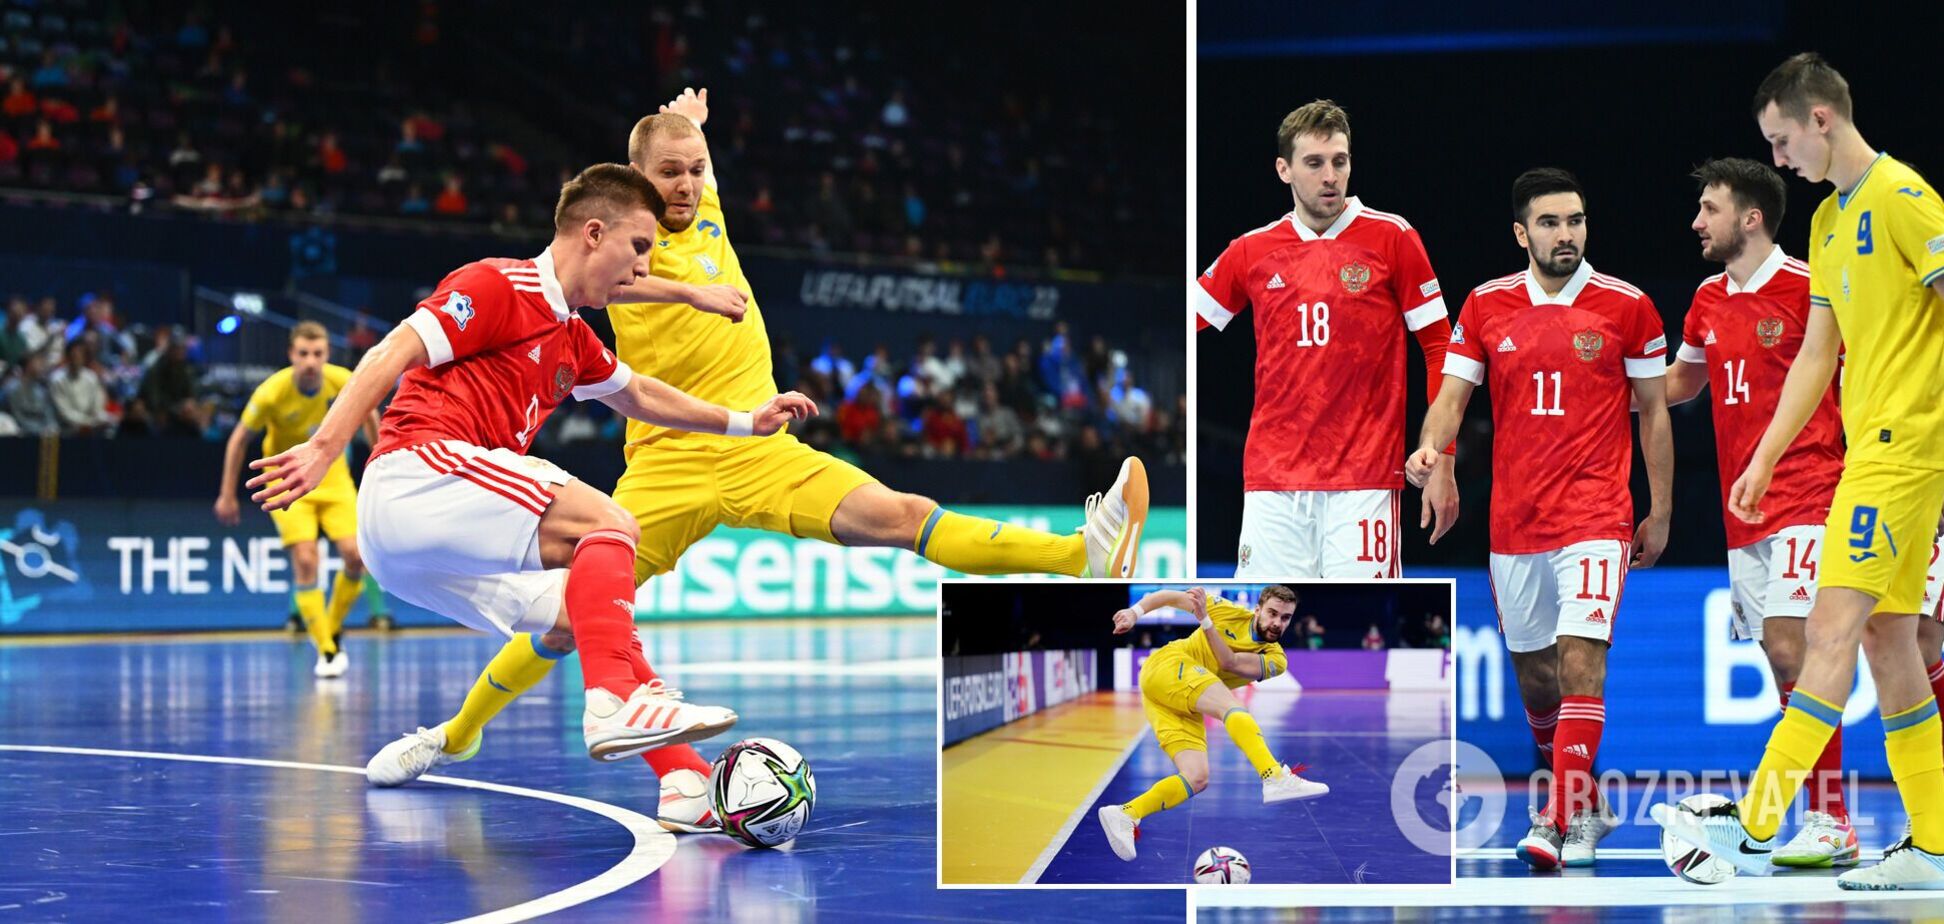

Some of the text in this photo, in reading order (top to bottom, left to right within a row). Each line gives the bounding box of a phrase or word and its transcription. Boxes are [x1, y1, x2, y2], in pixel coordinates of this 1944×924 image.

[1857, 210, 1874, 256] 9
[1296, 301, 1330, 347] 18
[1530, 370, 1566, 416] 11
[1723, 358, 1751, 406] 14
[1357, 518, 1387, 563] 18
[1848, 505, 1879, 549] 9
[107, 536, 211, 595] THE
[1576, 557, 1611, 602] 11
[1782, 537, 1816, 581] 14
